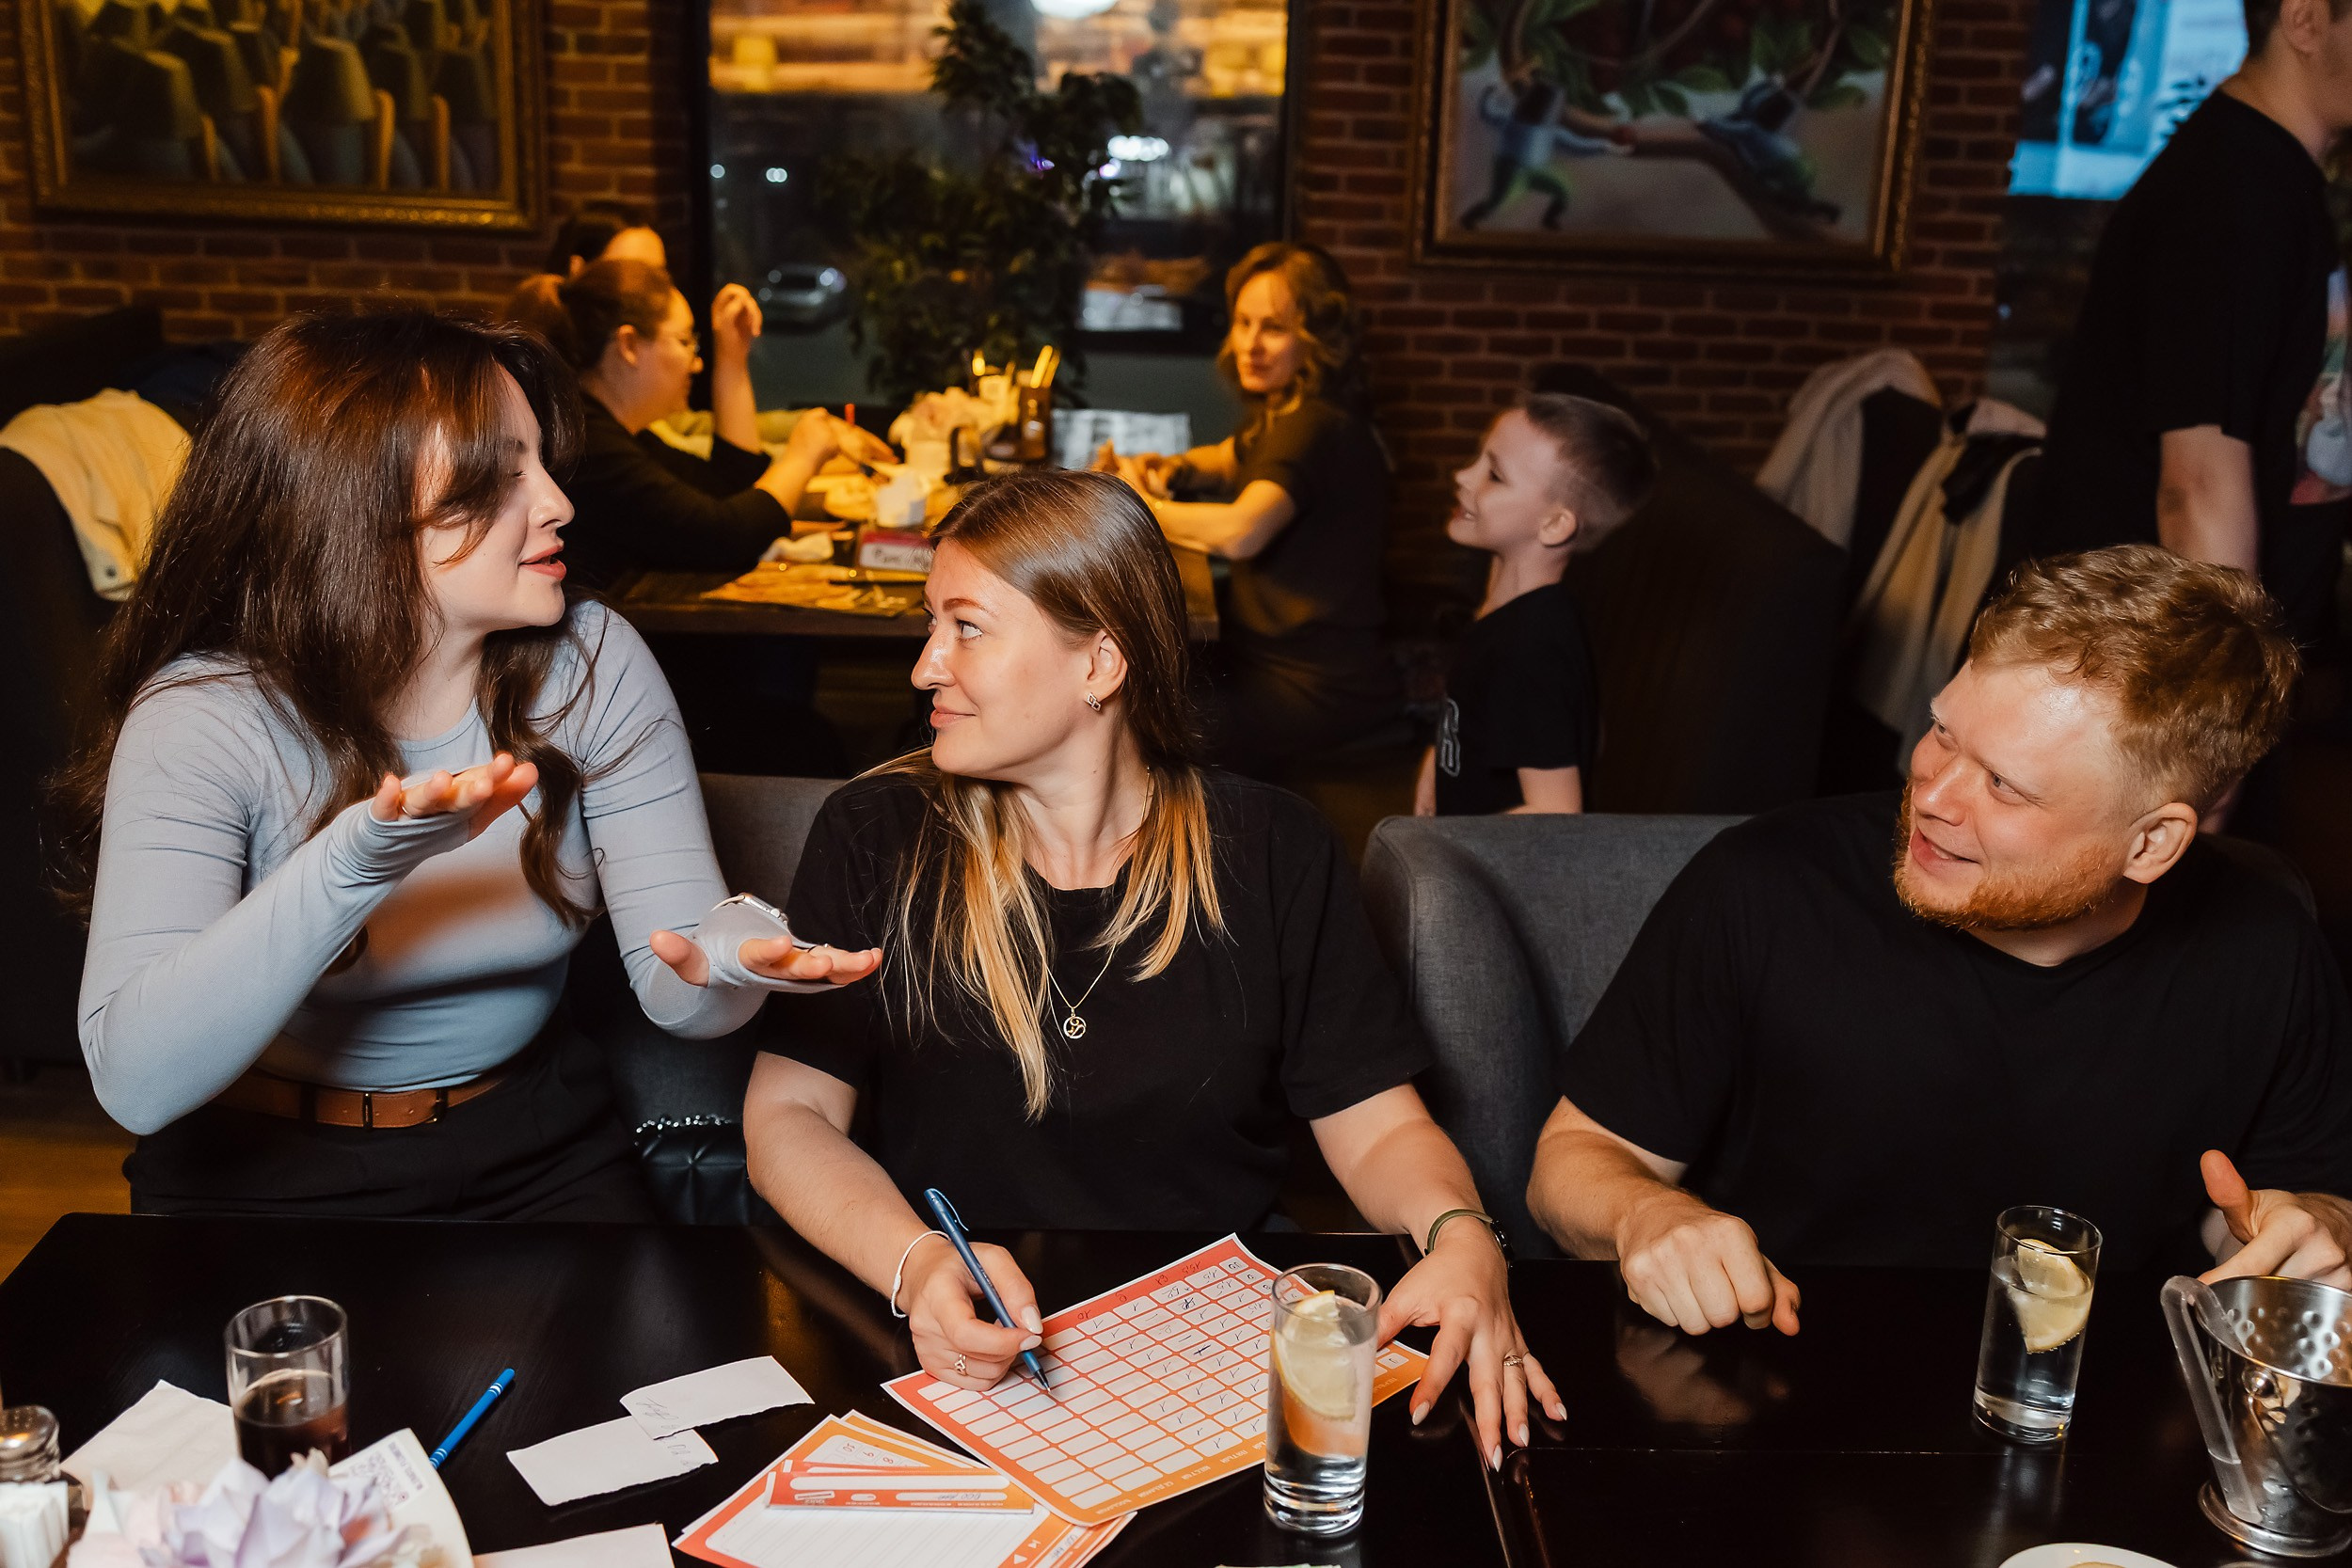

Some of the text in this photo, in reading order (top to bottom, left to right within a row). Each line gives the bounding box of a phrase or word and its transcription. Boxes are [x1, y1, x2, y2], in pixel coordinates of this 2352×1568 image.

[1219, 1449, 1248, 1464] ПЯТЫЙ
[1182, 1465, 1211, 1481] ШЕСТОЙ
[1137, 1481, 1175, 1498] СЕДЬМОЙ
